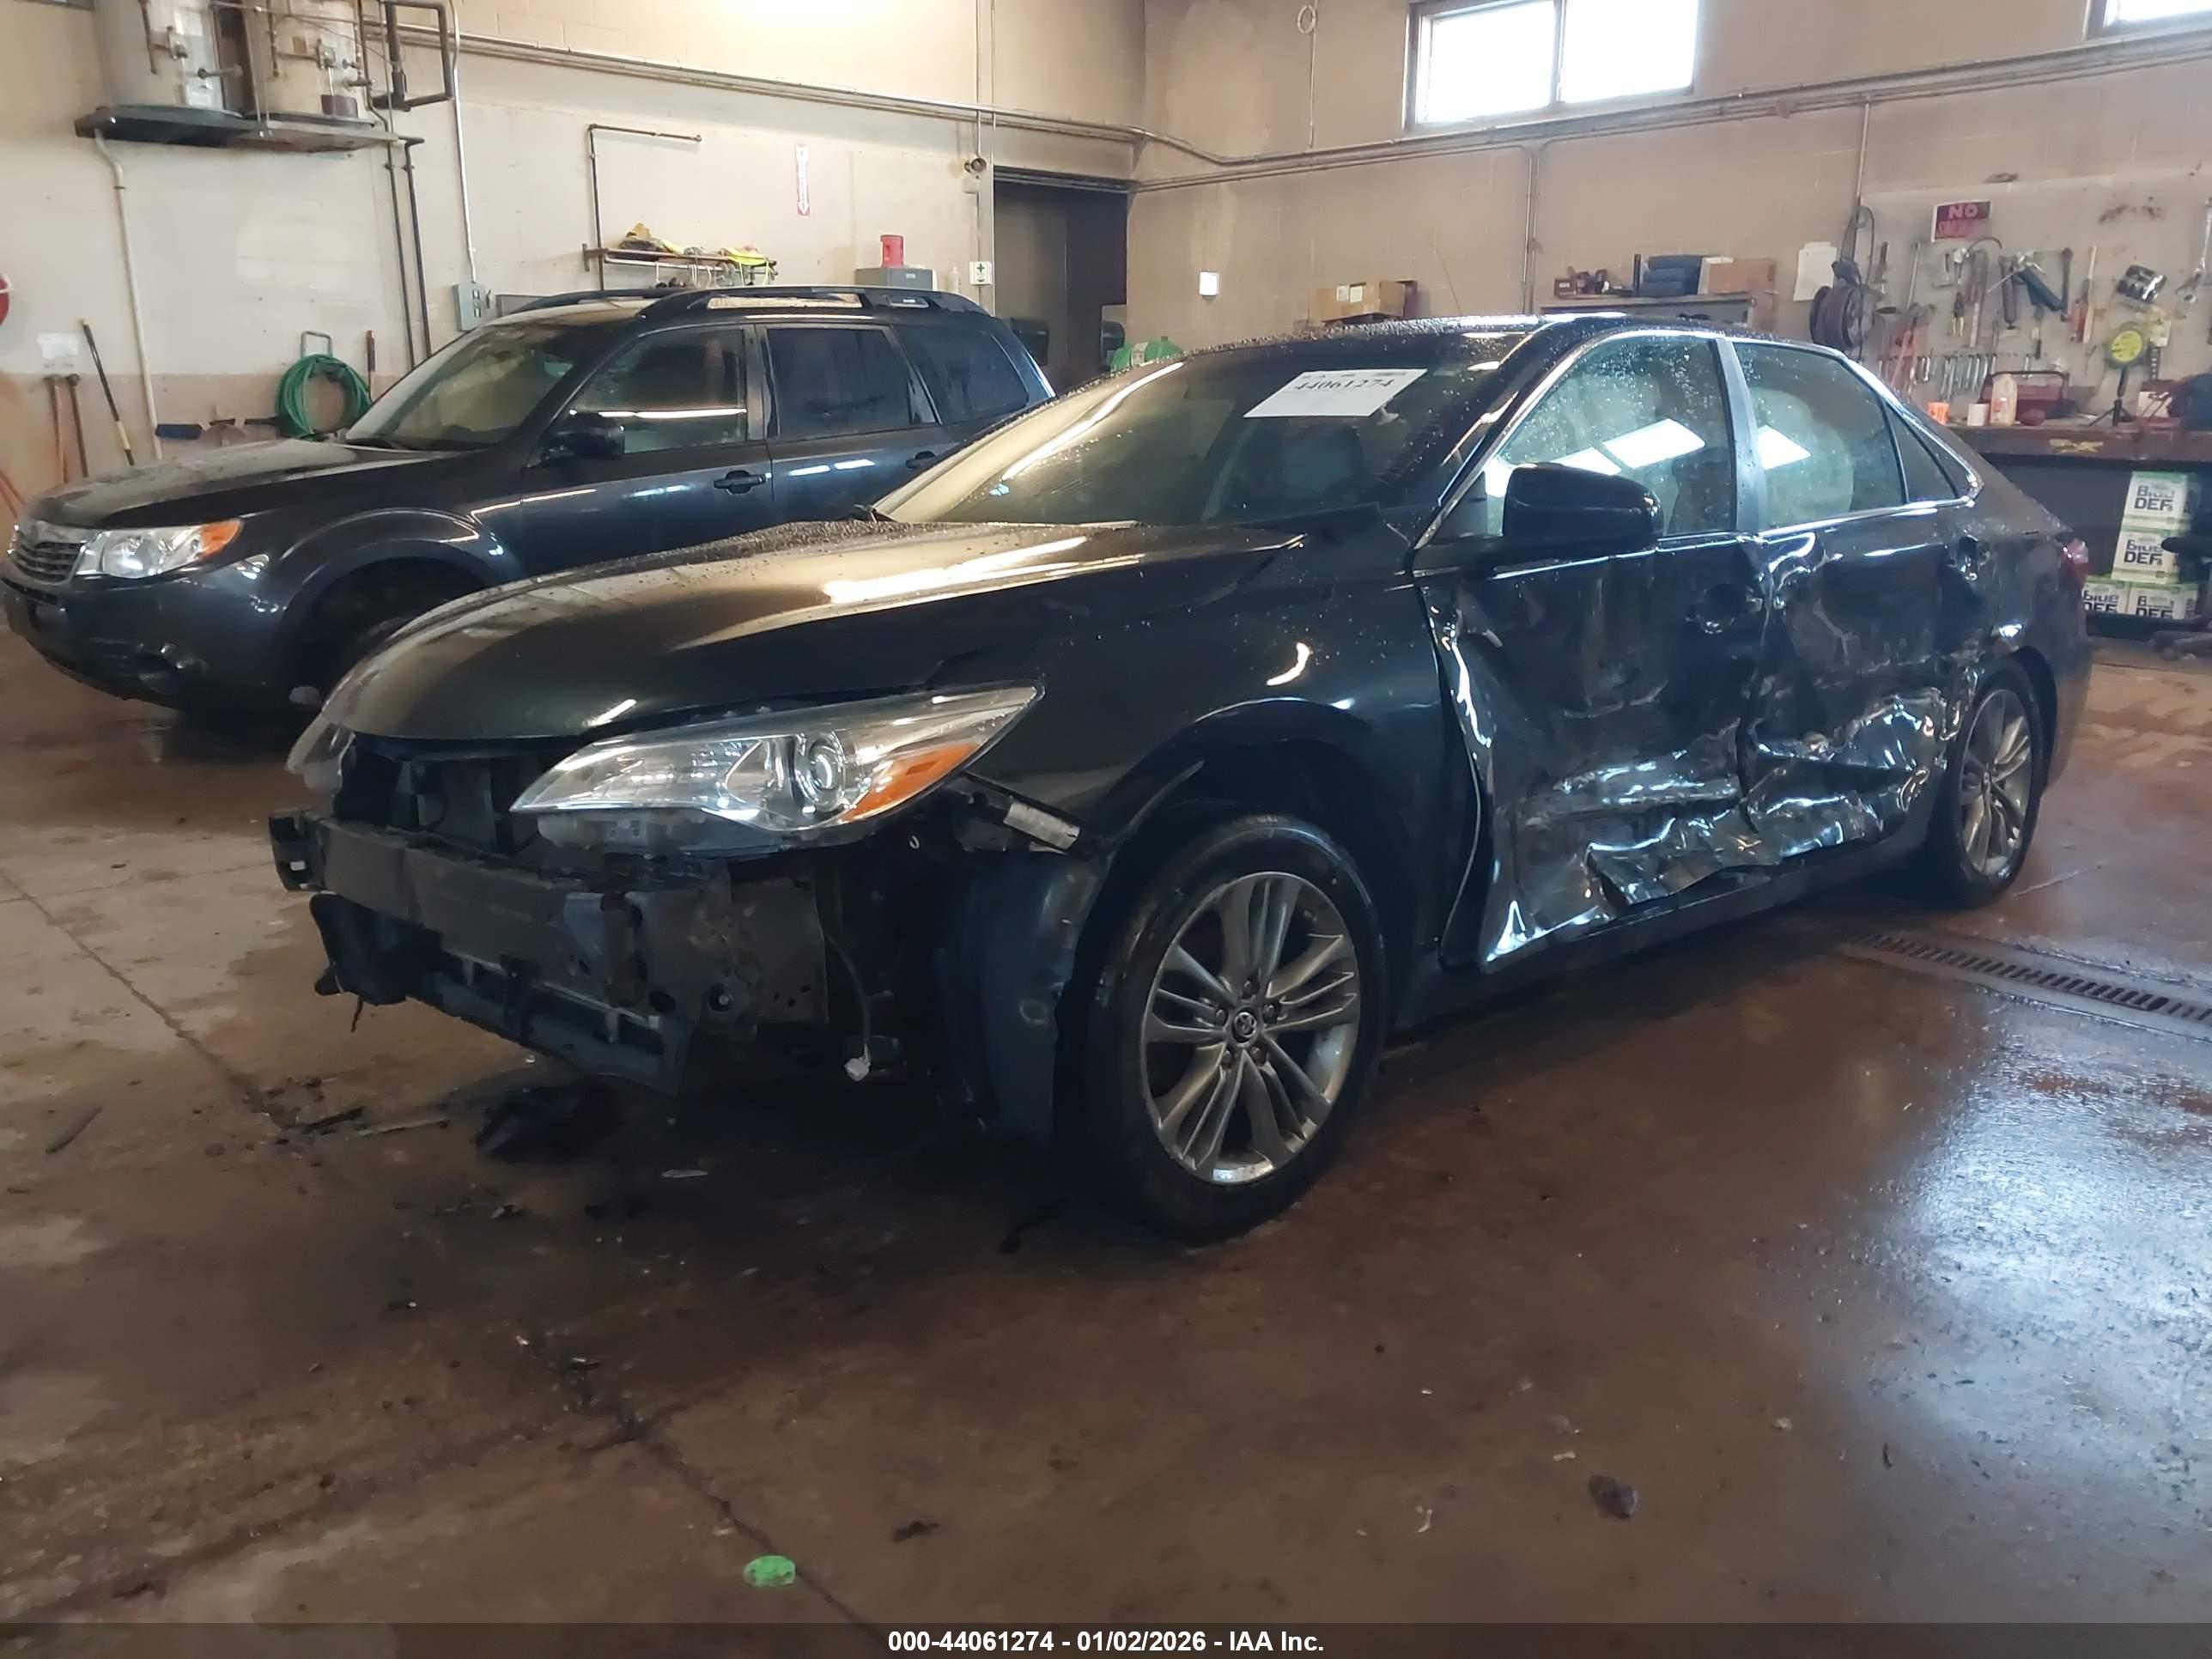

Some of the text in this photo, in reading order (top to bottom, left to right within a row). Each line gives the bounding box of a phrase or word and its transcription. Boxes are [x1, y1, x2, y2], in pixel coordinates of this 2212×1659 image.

[1948, 204, 1978, 219] NO
[1294, 378, 1395, 391] 44061274
[2134, 497, 2173, 511] DEF
[2124, 551, 2162, 565] DEF
